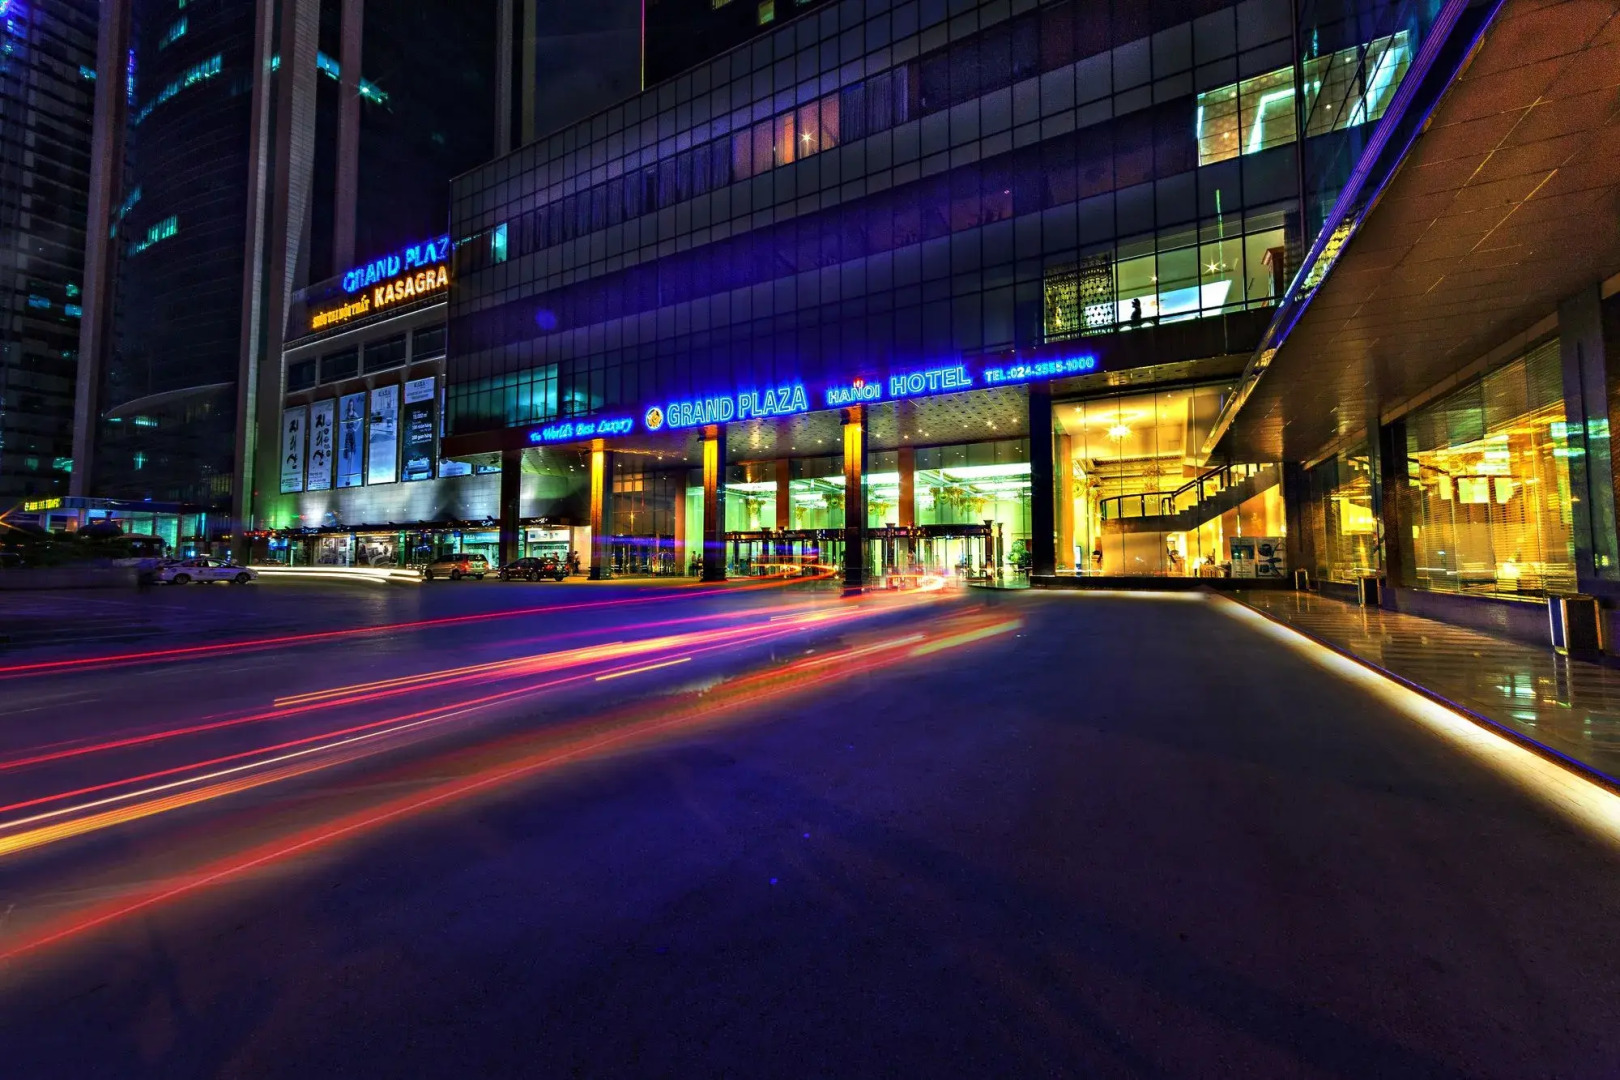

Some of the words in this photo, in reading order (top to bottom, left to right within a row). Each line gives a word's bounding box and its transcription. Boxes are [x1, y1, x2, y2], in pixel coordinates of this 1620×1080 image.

[343, 254, 401, 293] GRAND
[828, 384, 880, 404] HANOI
[890, 366, 972, 396] HOTEL
[666, 395, 734, 428] GRAND
[738, 384, 808, 419] PLAZA
[575, 422, 595, 437] Best
[597, 417, 633, 434] Luxury
